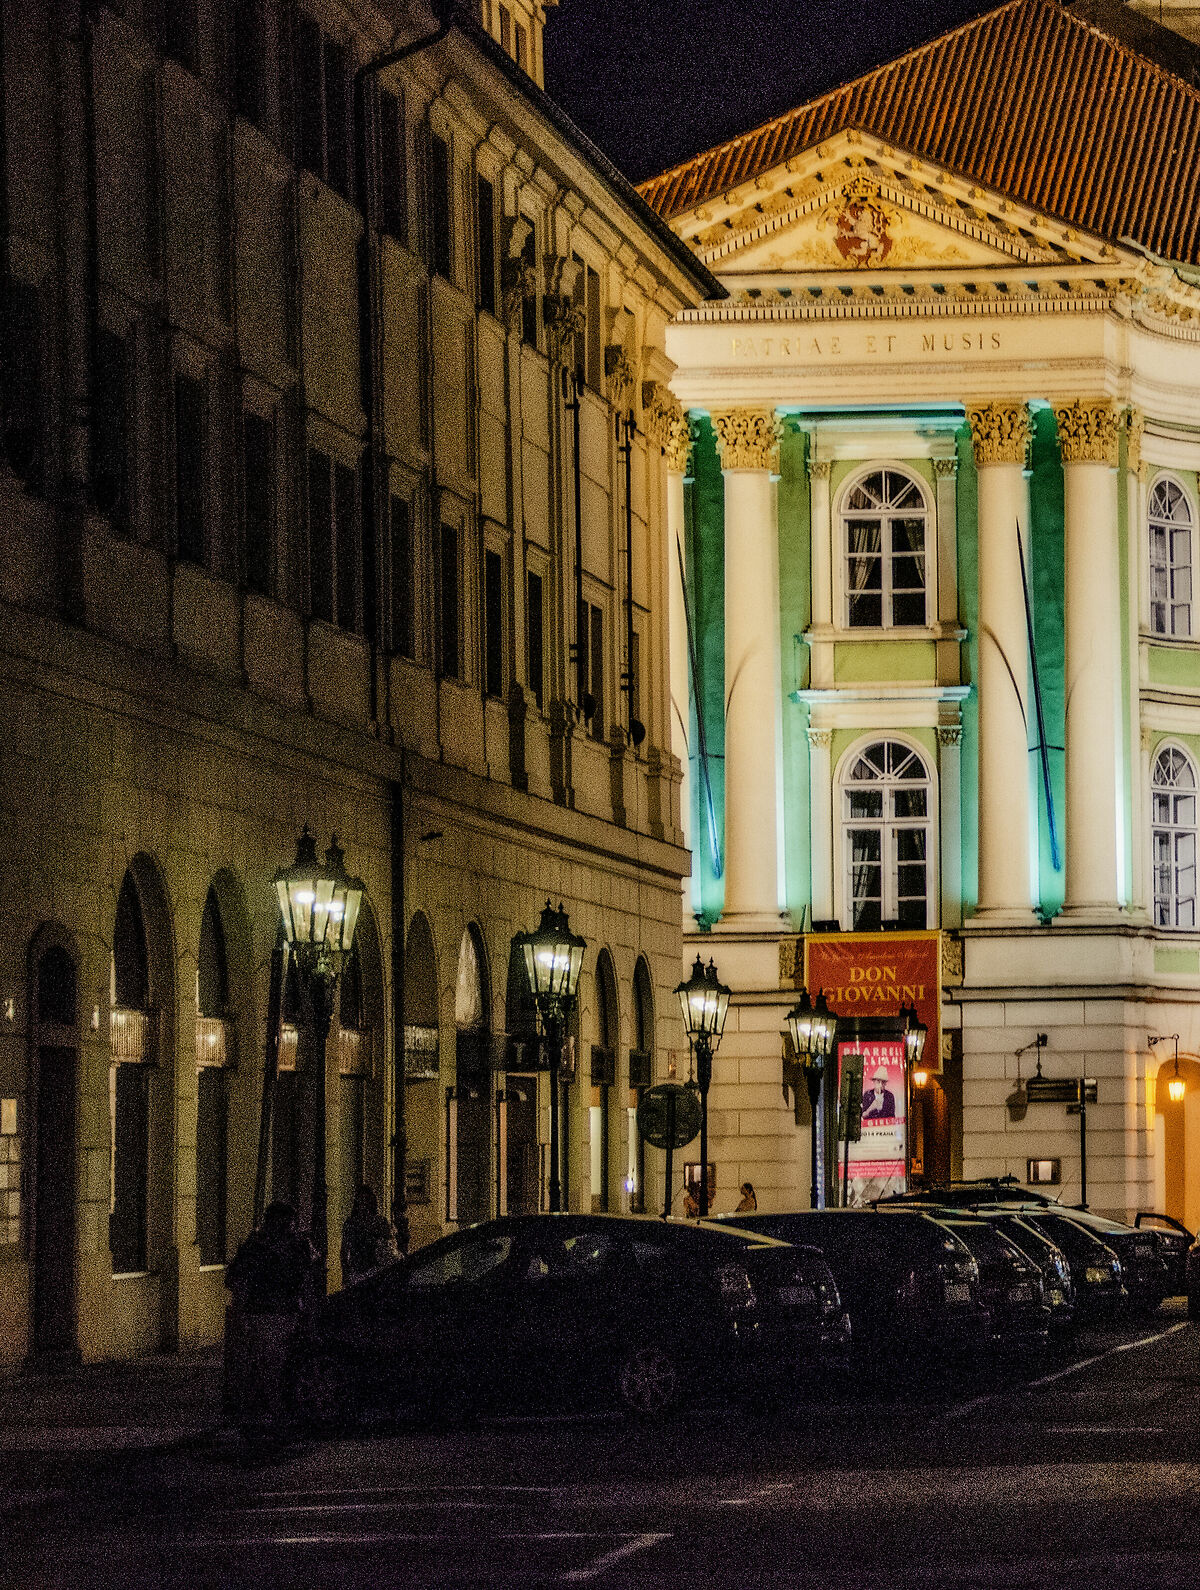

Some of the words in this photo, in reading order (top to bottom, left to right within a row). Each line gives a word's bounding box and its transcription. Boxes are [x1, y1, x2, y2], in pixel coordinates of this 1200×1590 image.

[731, 336, 841, 357] PATRIAE
[866, 335, 897, 353] ET
[922, 332, 1001, 352] MUSIS
[849, 966, 897, 983] DON
[822, 984, 926, 1003] GIOVANNI
[843, 1047, 902, 1057] PHARRELL
[863, 1056, 904, 1066] LLIAMS
